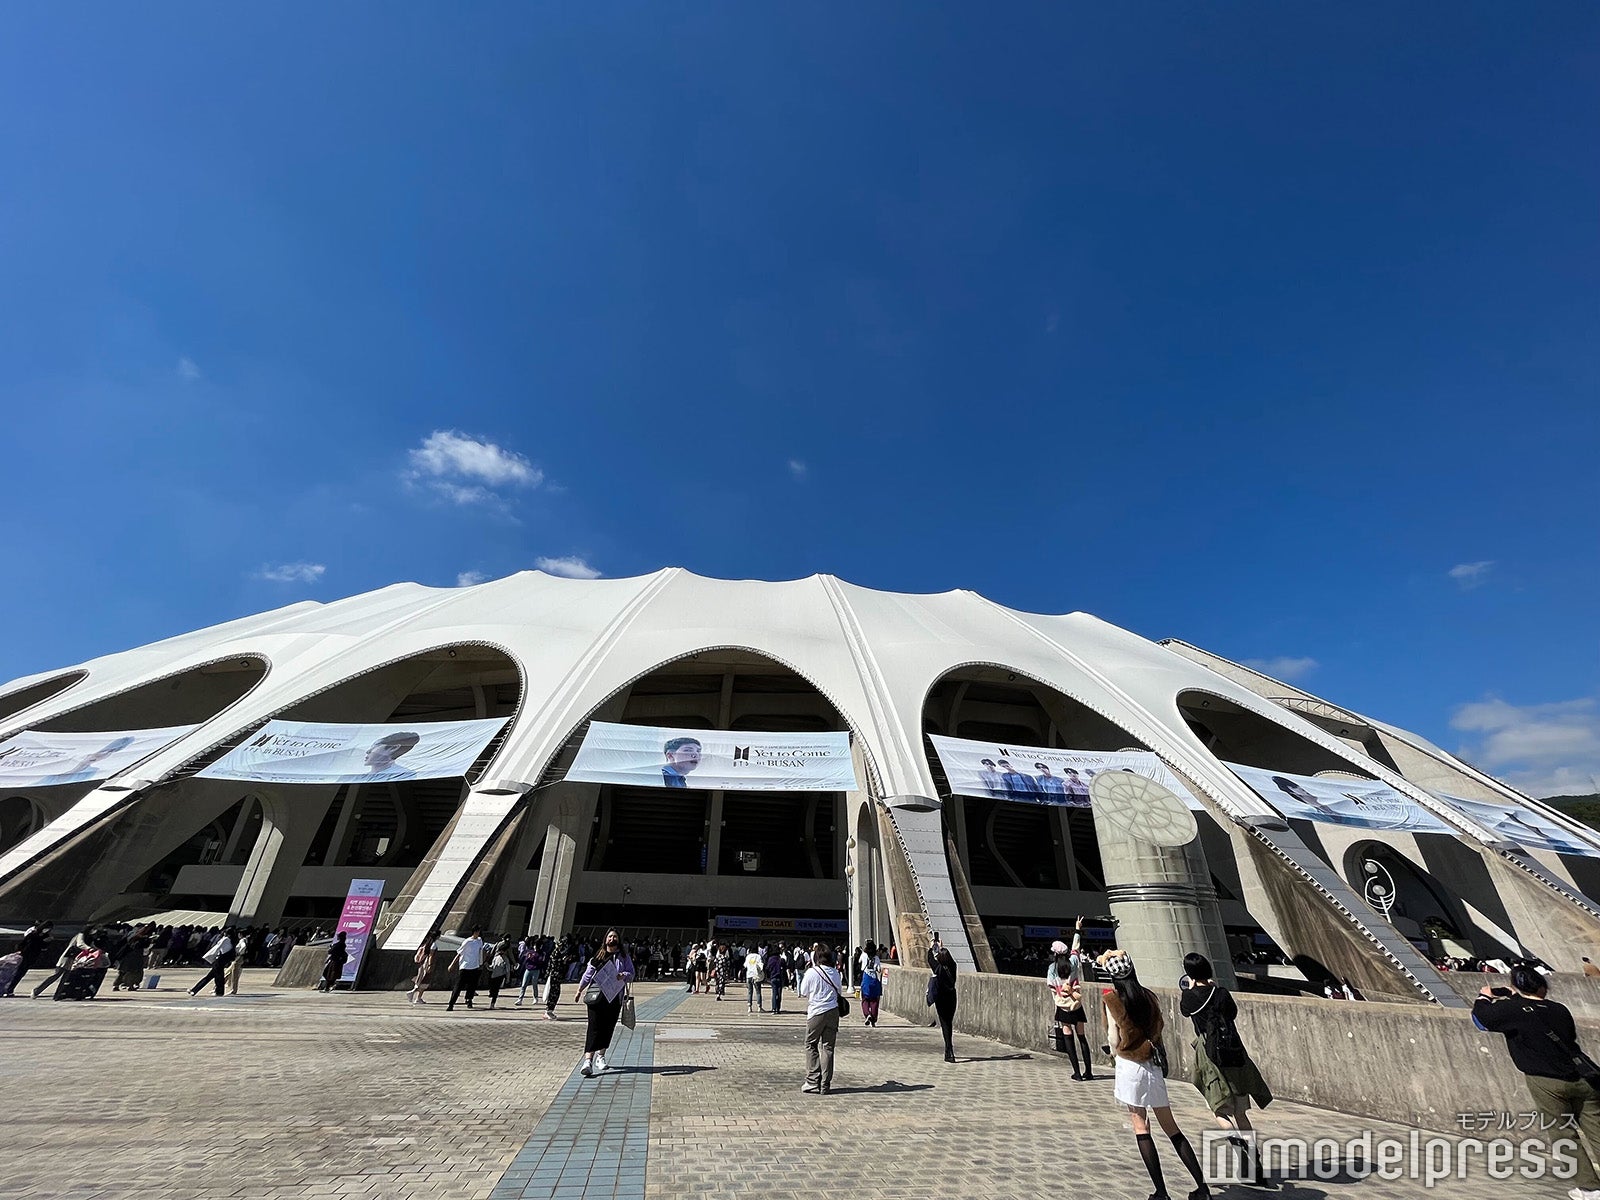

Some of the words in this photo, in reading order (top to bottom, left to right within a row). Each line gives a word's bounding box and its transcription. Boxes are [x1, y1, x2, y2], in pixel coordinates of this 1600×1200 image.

[304, 740, 341, 749] Come
[754, 749, 773, 757] Yet
[791, 749, 830, 757] Come
[767, 759, 805, 767] BUSAN
[774, 920, 793, 928] GATE
